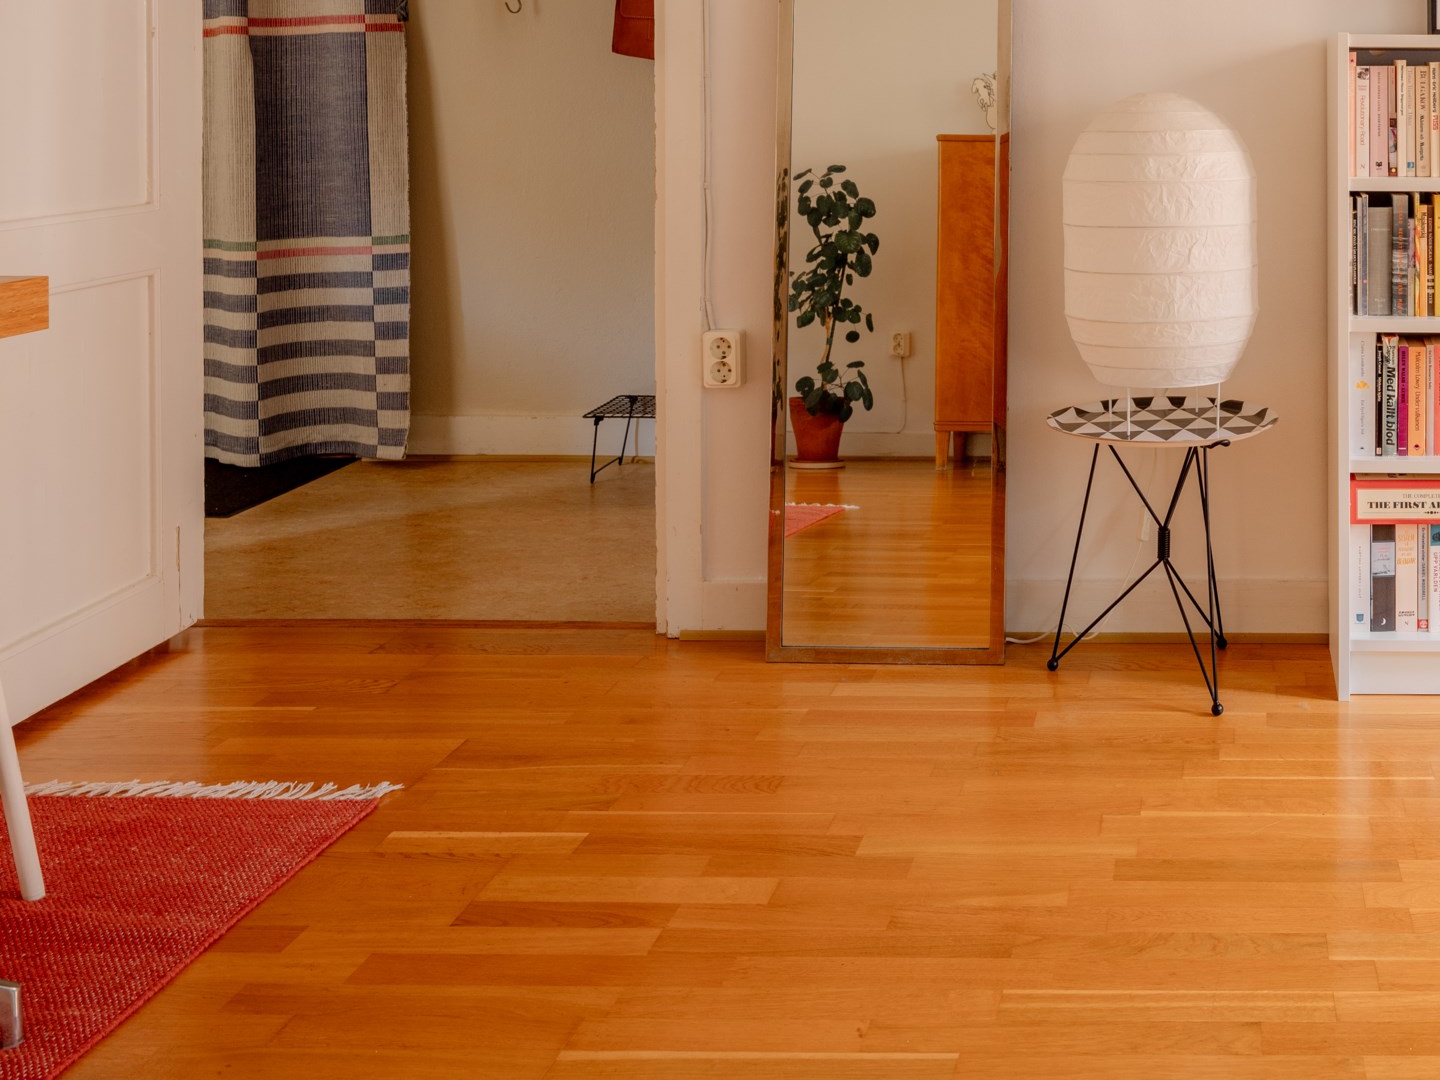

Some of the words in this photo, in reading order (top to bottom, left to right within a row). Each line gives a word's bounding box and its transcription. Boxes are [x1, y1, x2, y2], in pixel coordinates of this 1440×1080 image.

[1386, 366, 1396, 392] Med
[1386, 394, 1396, 419] kallt
[1386, 420, 1396, 446] blod
[1367, 501, 1391, 509] THE
[1393, 501, 1428, 509] FIRST
